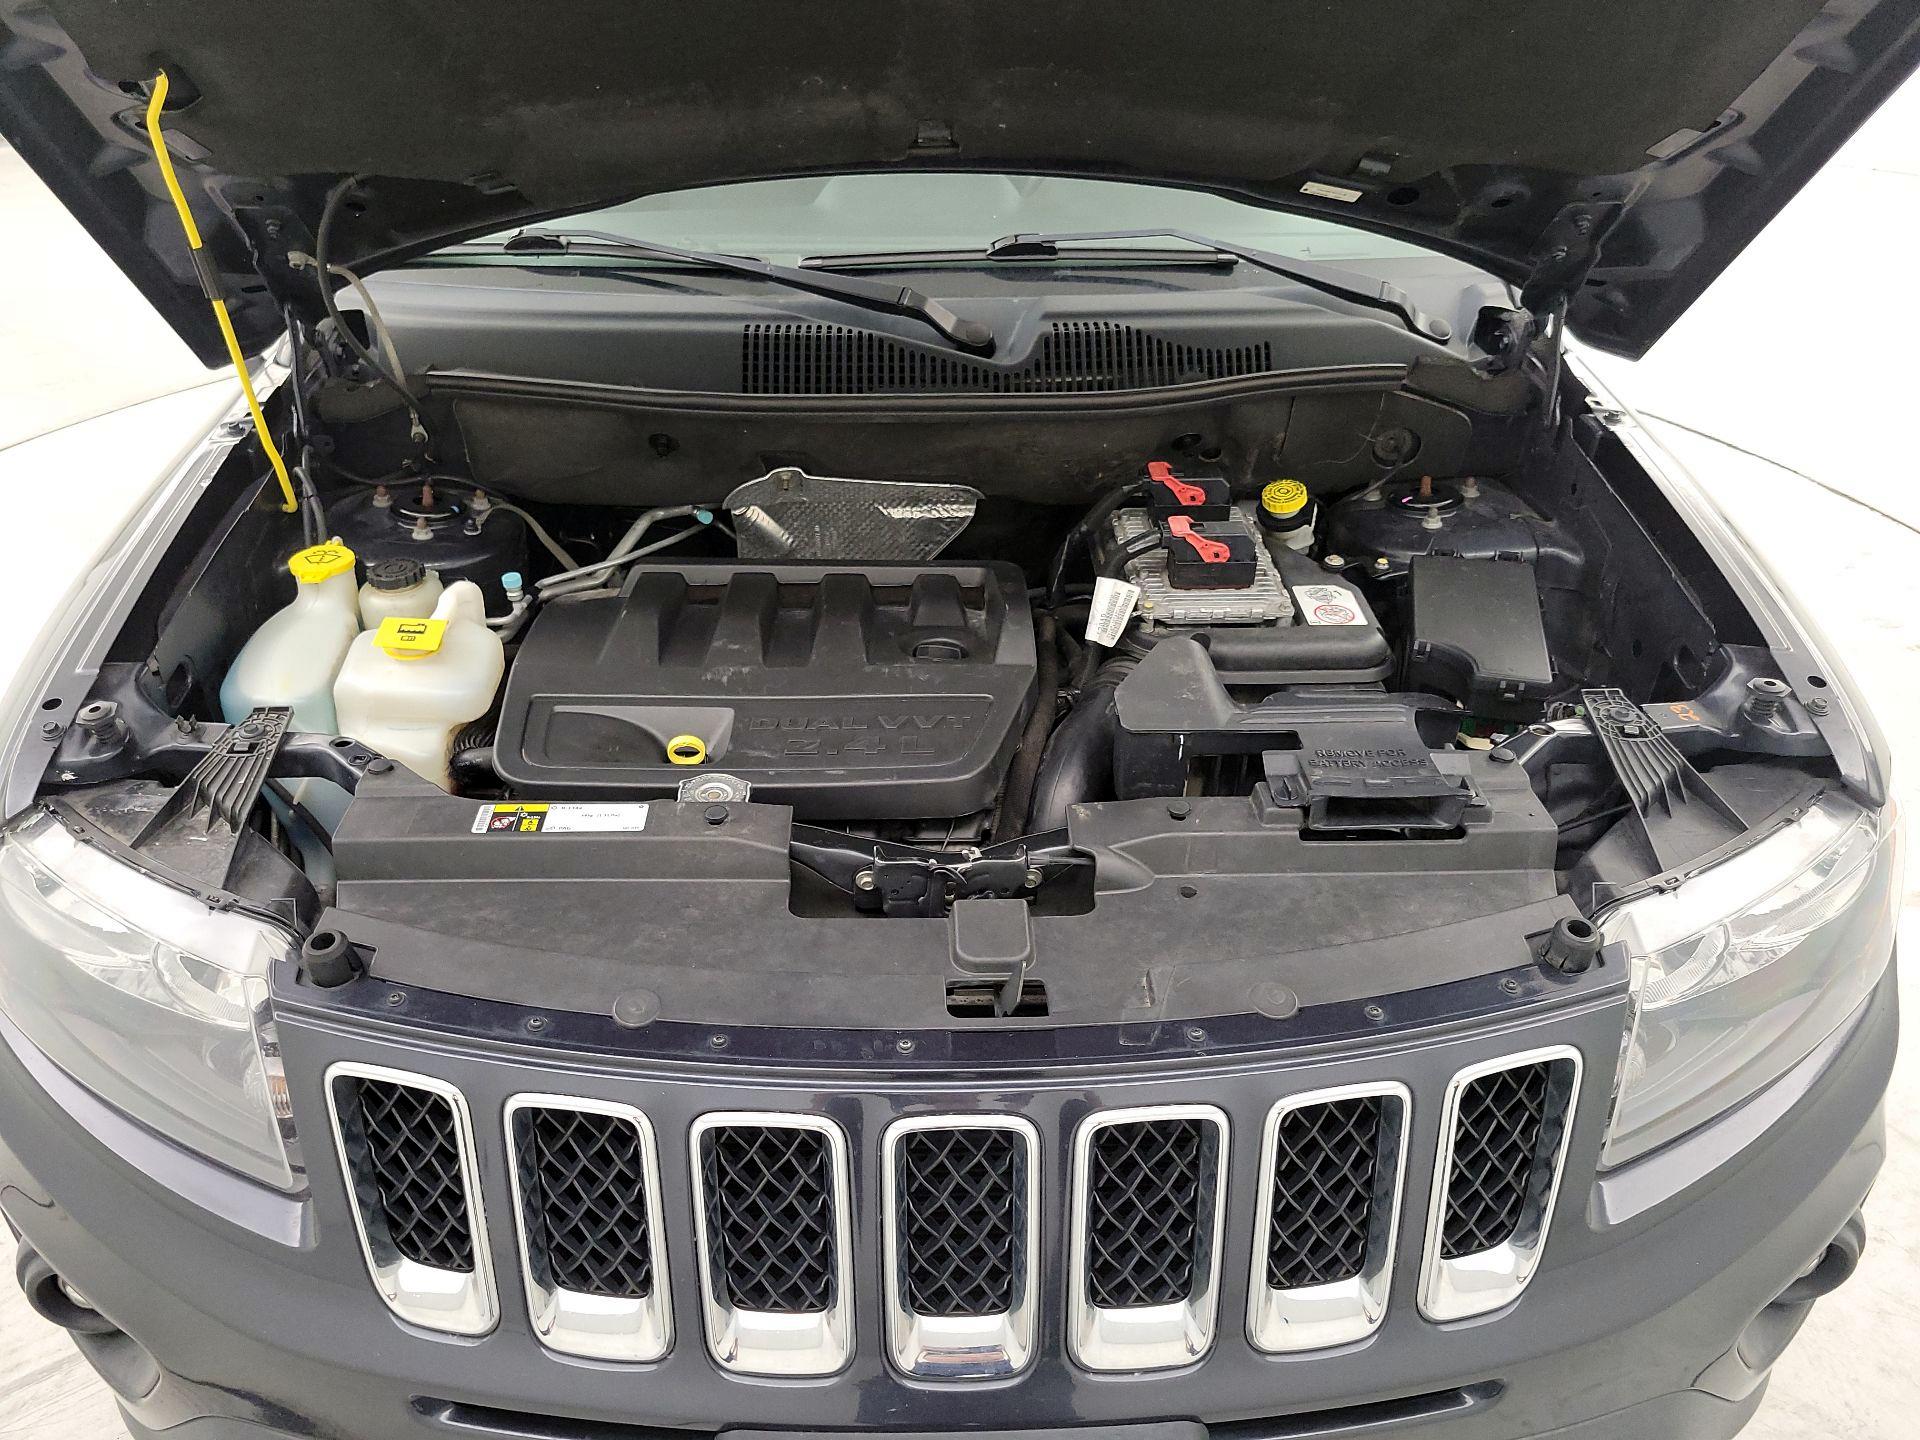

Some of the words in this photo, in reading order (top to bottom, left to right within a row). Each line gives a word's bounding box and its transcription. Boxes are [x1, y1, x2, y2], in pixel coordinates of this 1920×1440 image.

[749, 716, 868, 730] DUAL
[878, 715, 971, 729] VVT
[784, 735, 935, 755] 2.4L
[1315, 748, 1375, 758] REMOVE
[1377, 748, 1407, 758] FOR
[1308, 759, 1366, 769] BATTERY
[1372, 758, 1429, 768] ACCESS
